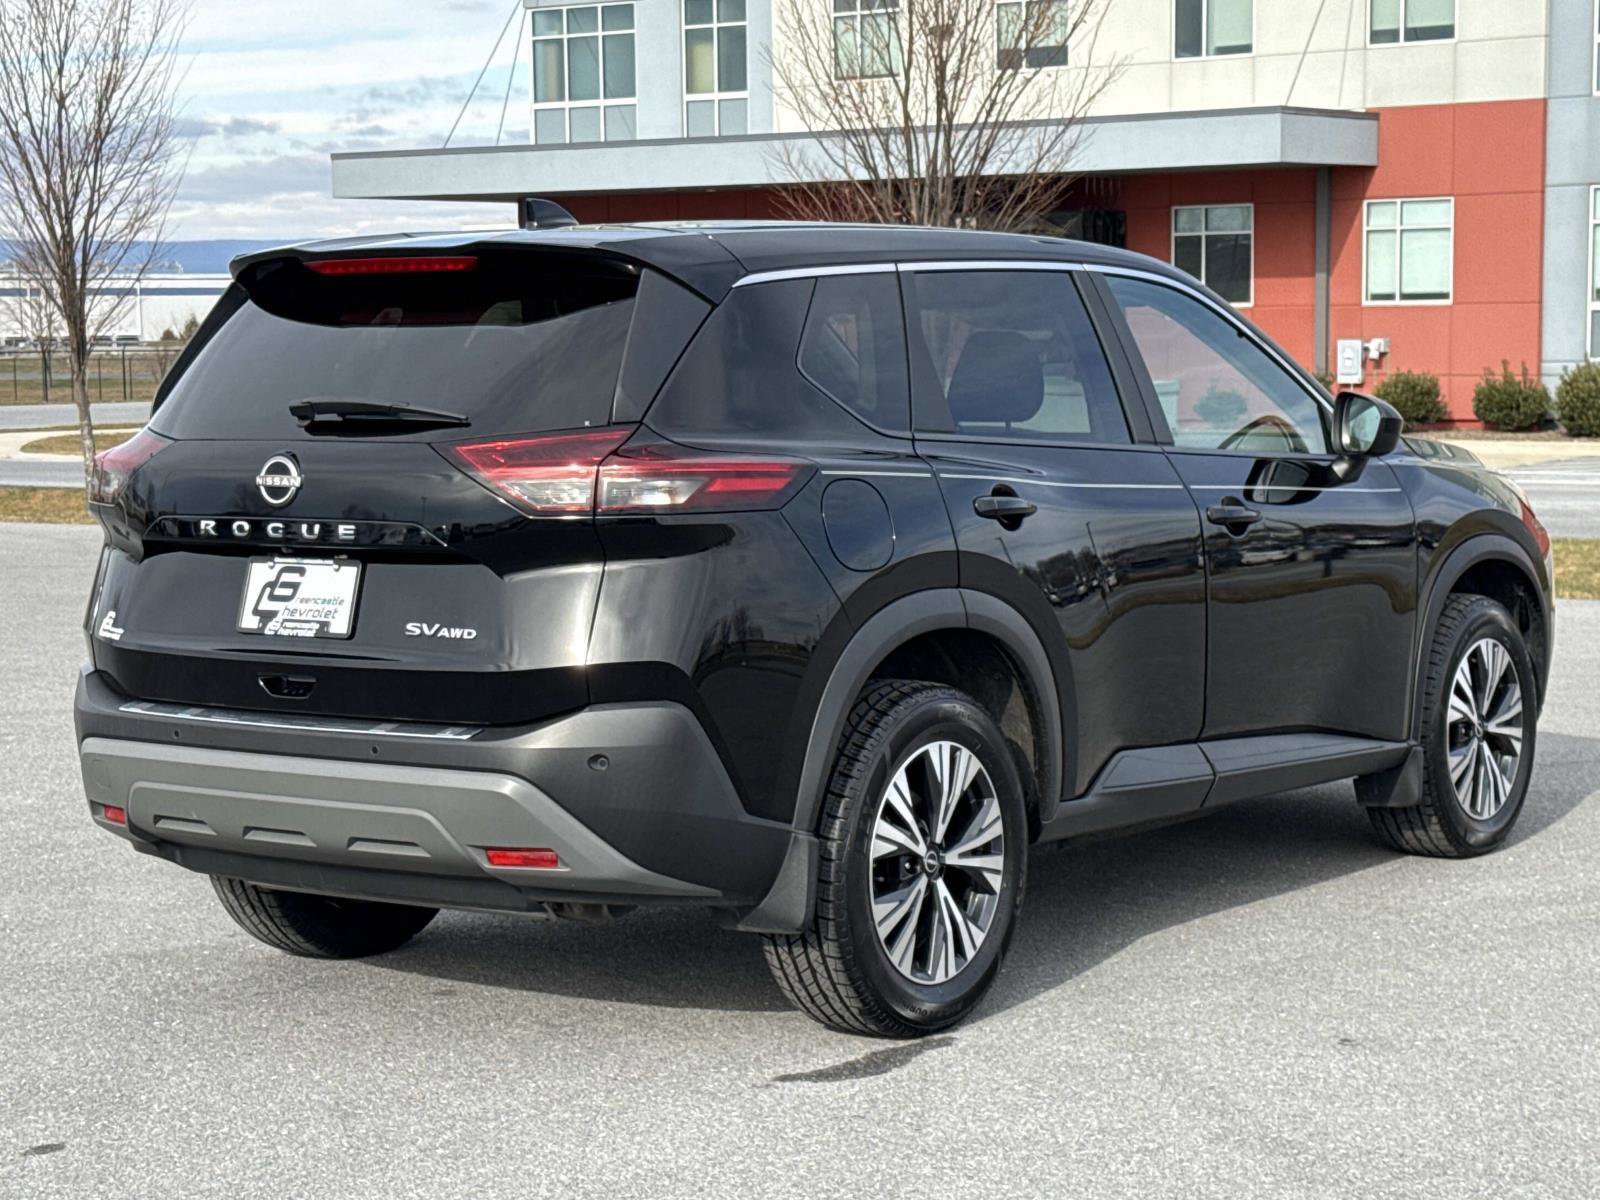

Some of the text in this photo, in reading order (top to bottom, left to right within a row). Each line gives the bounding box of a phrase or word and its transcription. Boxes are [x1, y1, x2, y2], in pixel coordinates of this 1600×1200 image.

[256, 475, 301, 487] NISSAN
[200, 520, 356, 540] ROGUE
[405, 622, 477, 640] SV AWD
